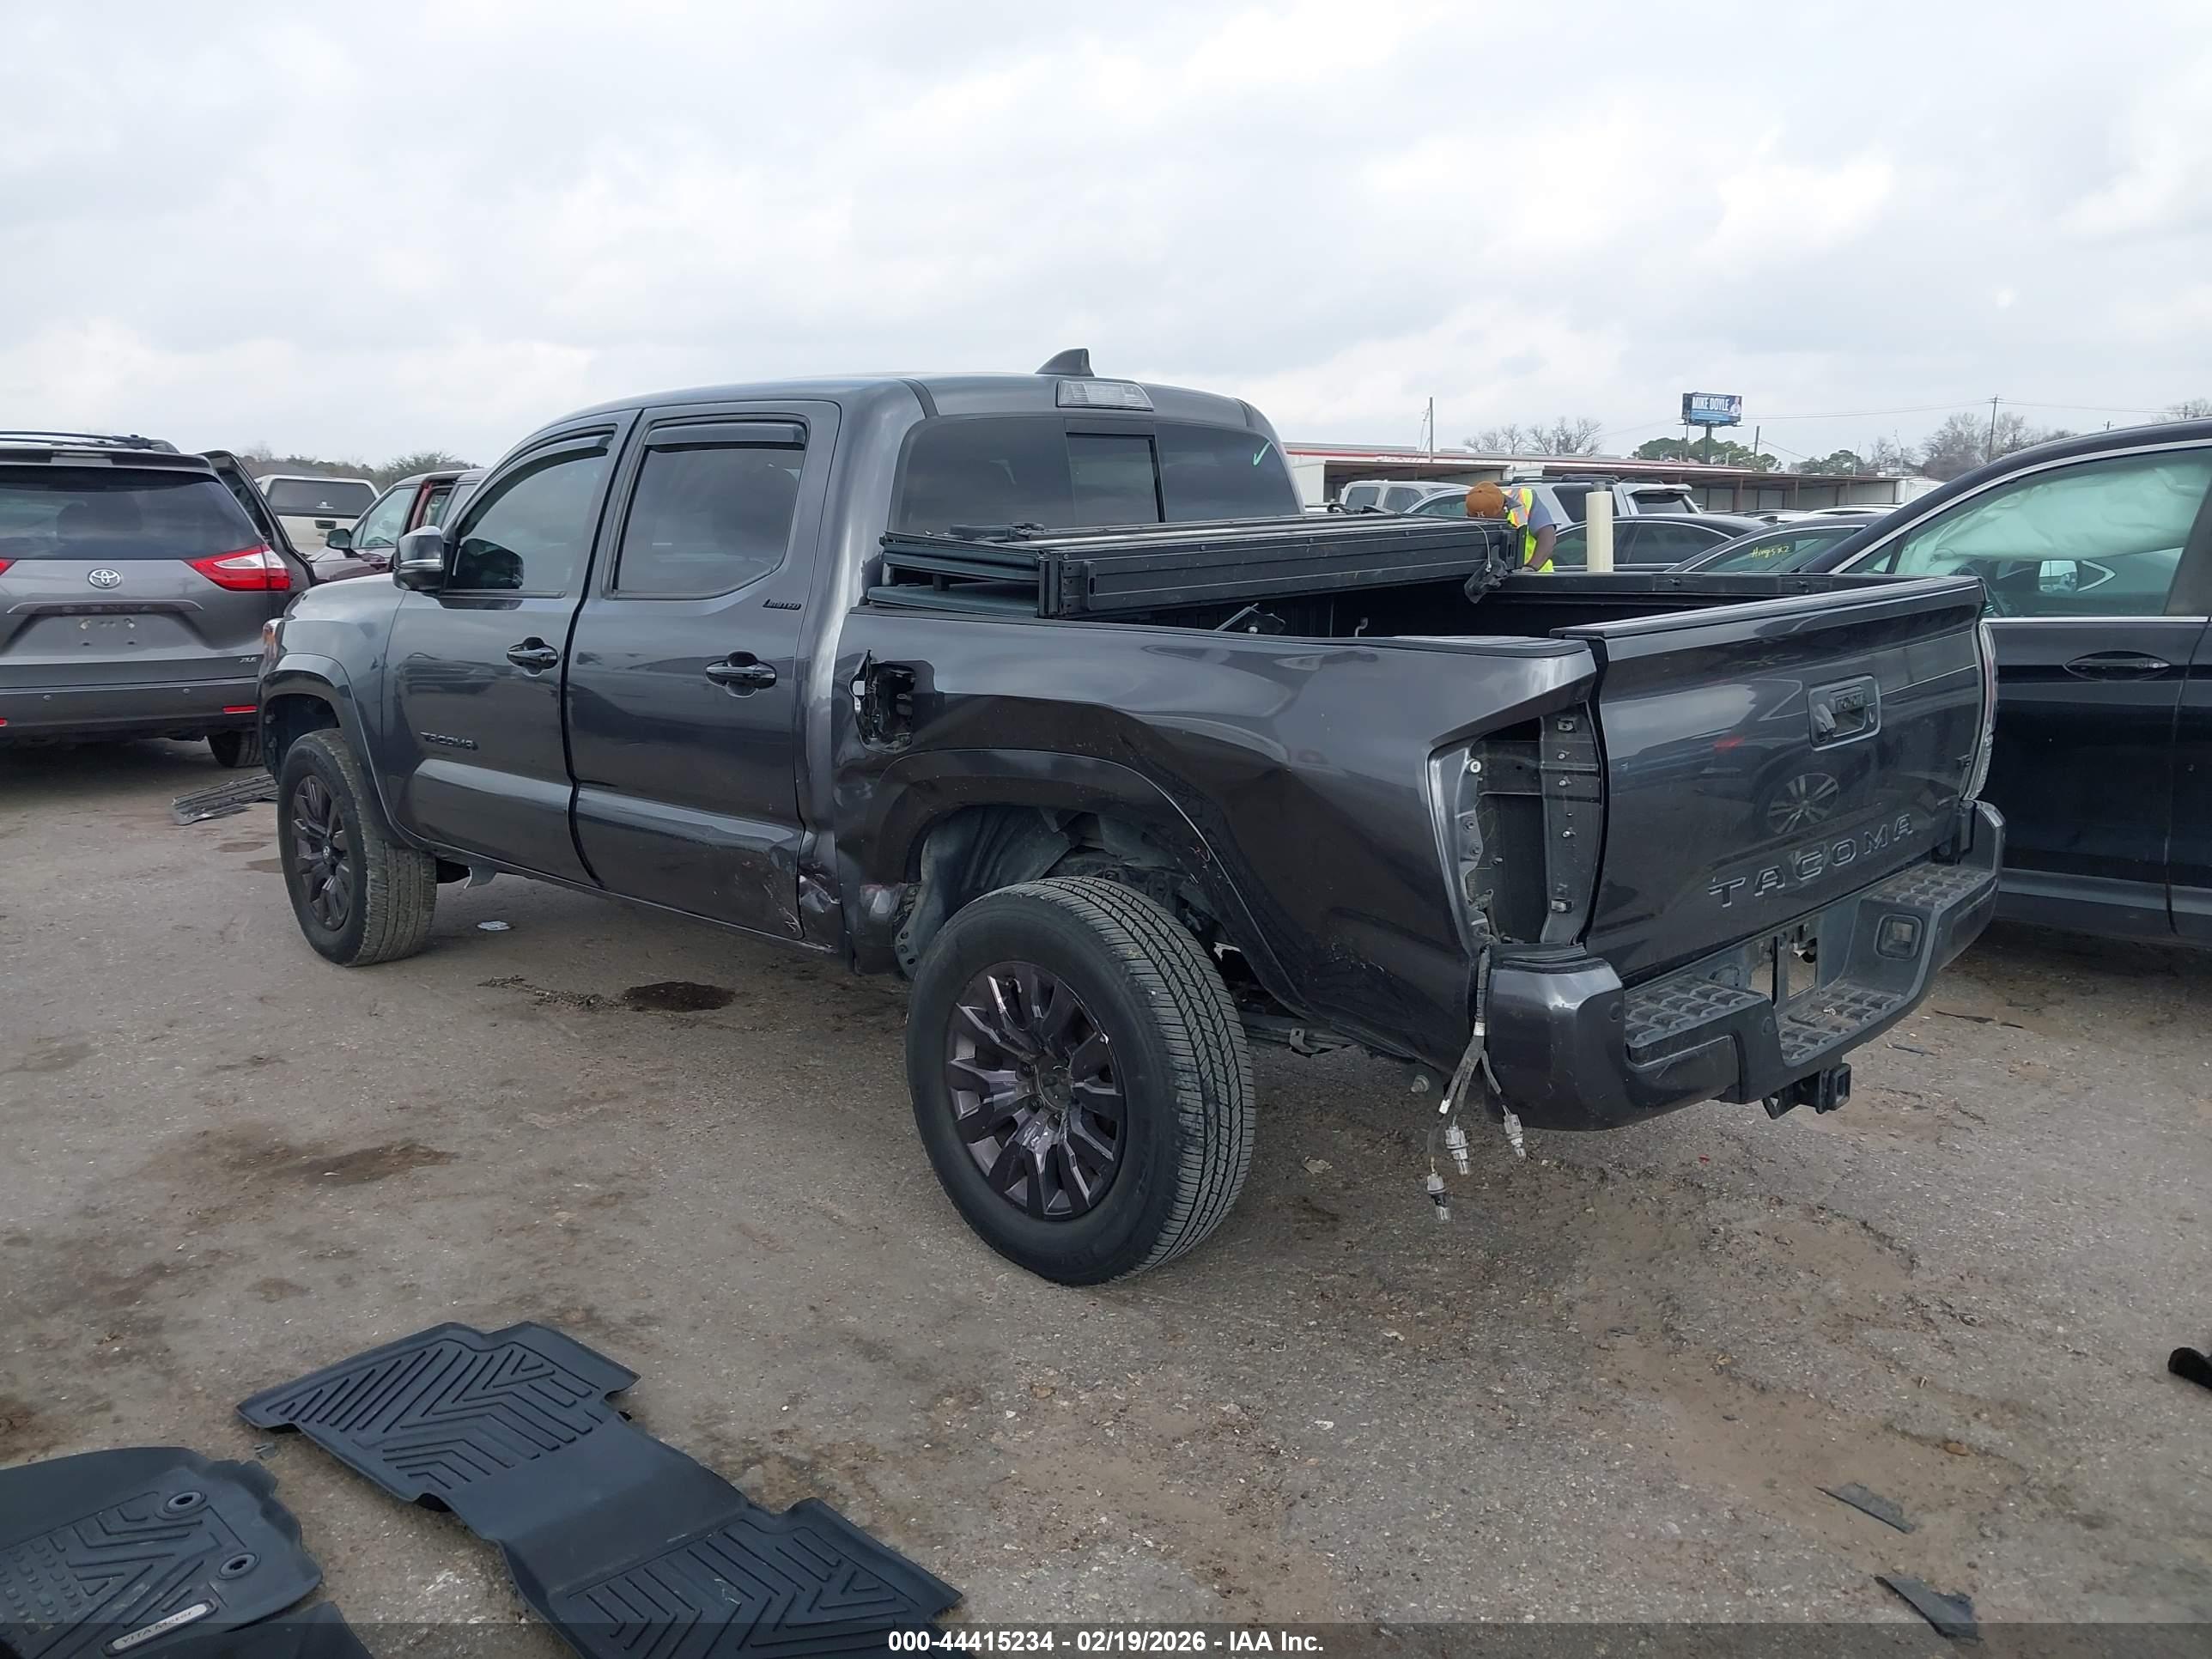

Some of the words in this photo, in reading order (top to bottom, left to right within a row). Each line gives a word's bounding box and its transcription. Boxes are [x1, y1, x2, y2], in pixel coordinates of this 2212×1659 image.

[1692, 397, 1709, 410] MIKE
[1710, 398, 1729, 411] DOYLE
[1708, 812, 1914, 908] TACOMA
